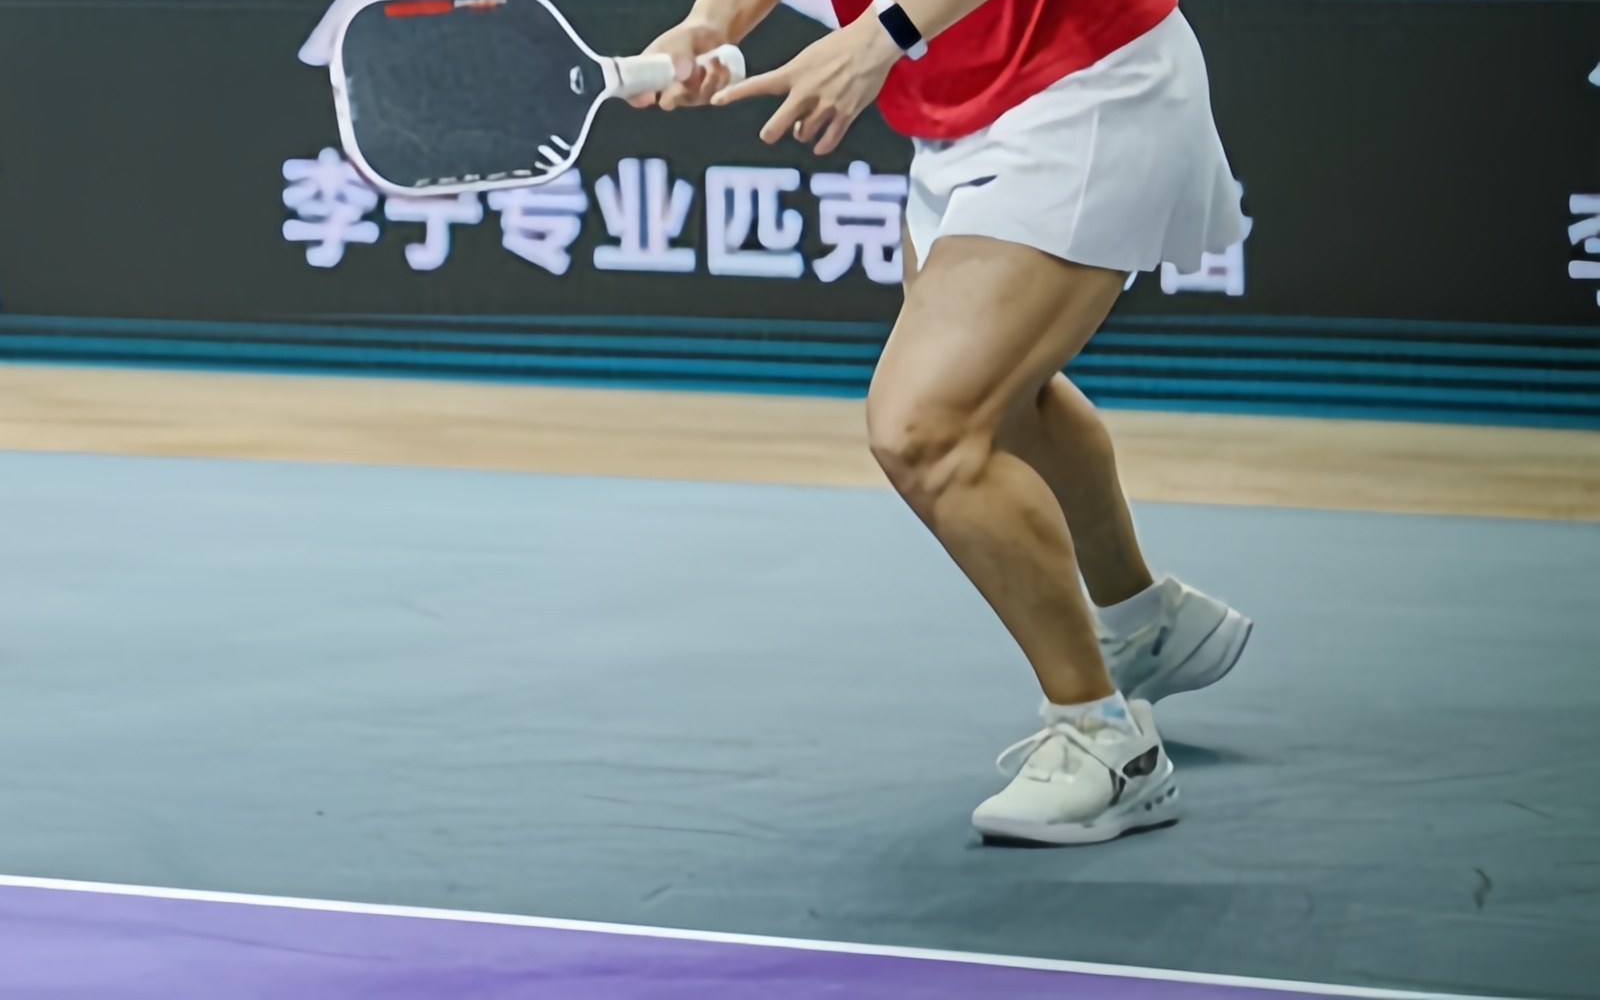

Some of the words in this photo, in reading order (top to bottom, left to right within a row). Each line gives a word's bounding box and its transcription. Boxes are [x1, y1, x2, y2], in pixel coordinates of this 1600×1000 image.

[282, 147, 1253, 296] 李宁专业匹克
